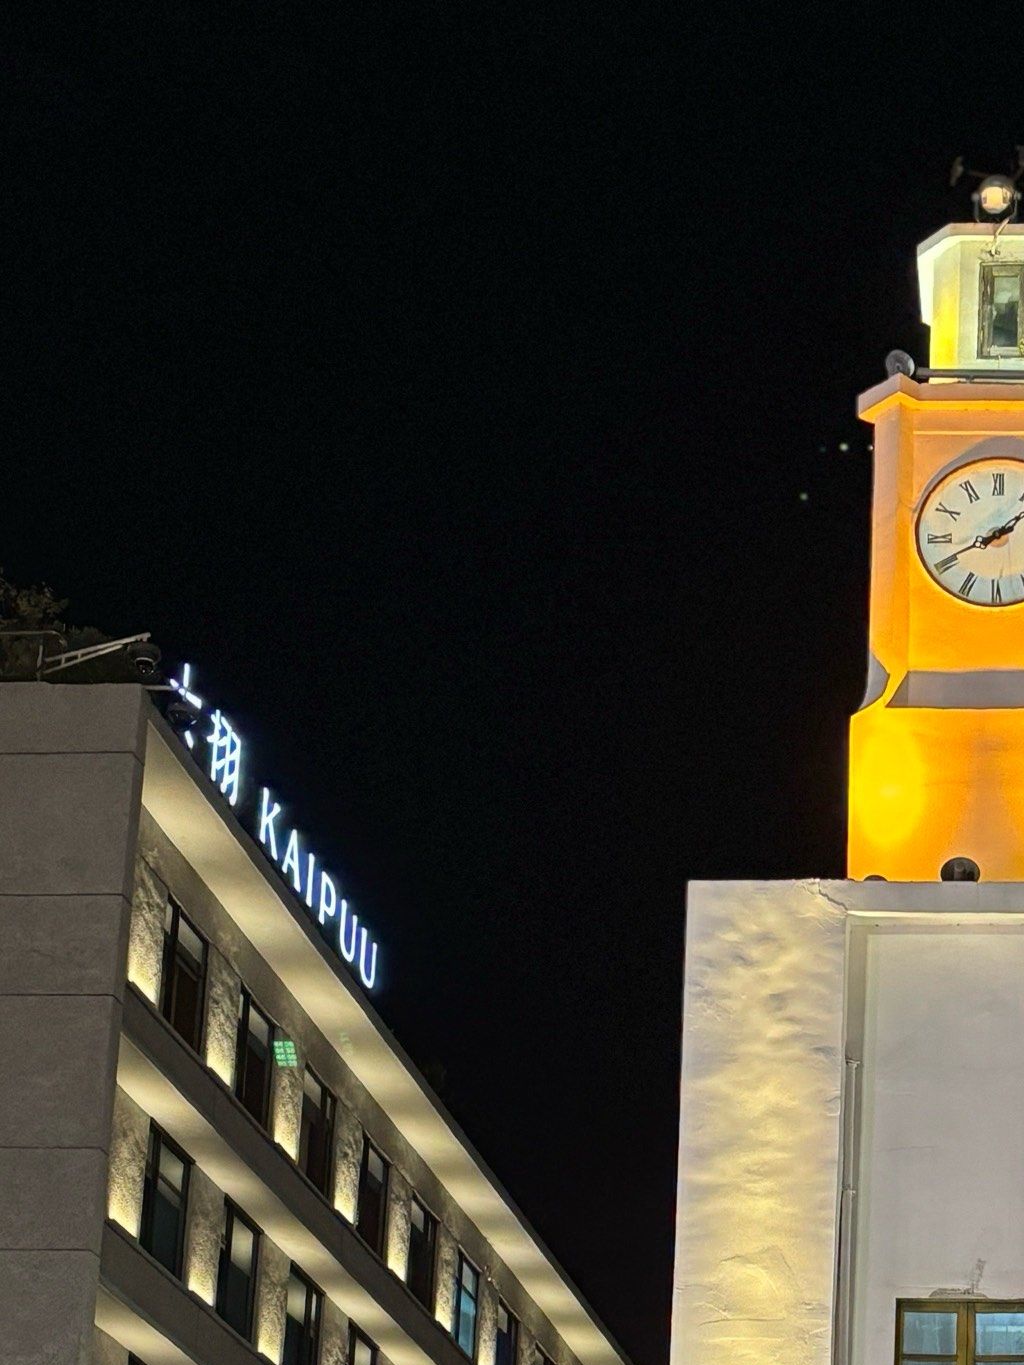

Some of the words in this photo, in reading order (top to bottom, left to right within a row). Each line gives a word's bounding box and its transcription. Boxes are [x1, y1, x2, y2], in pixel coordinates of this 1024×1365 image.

[959, 479, 980, 504] XI
[992, 473, 1005, 496] XII
[935, 502, 961, 522] X
[927, 532, 952, 544] IX
[959, 571, 978, 597] VII
[991, 578, 1002, 604] VI
[259, 786, 379, 990] KAIPUU
